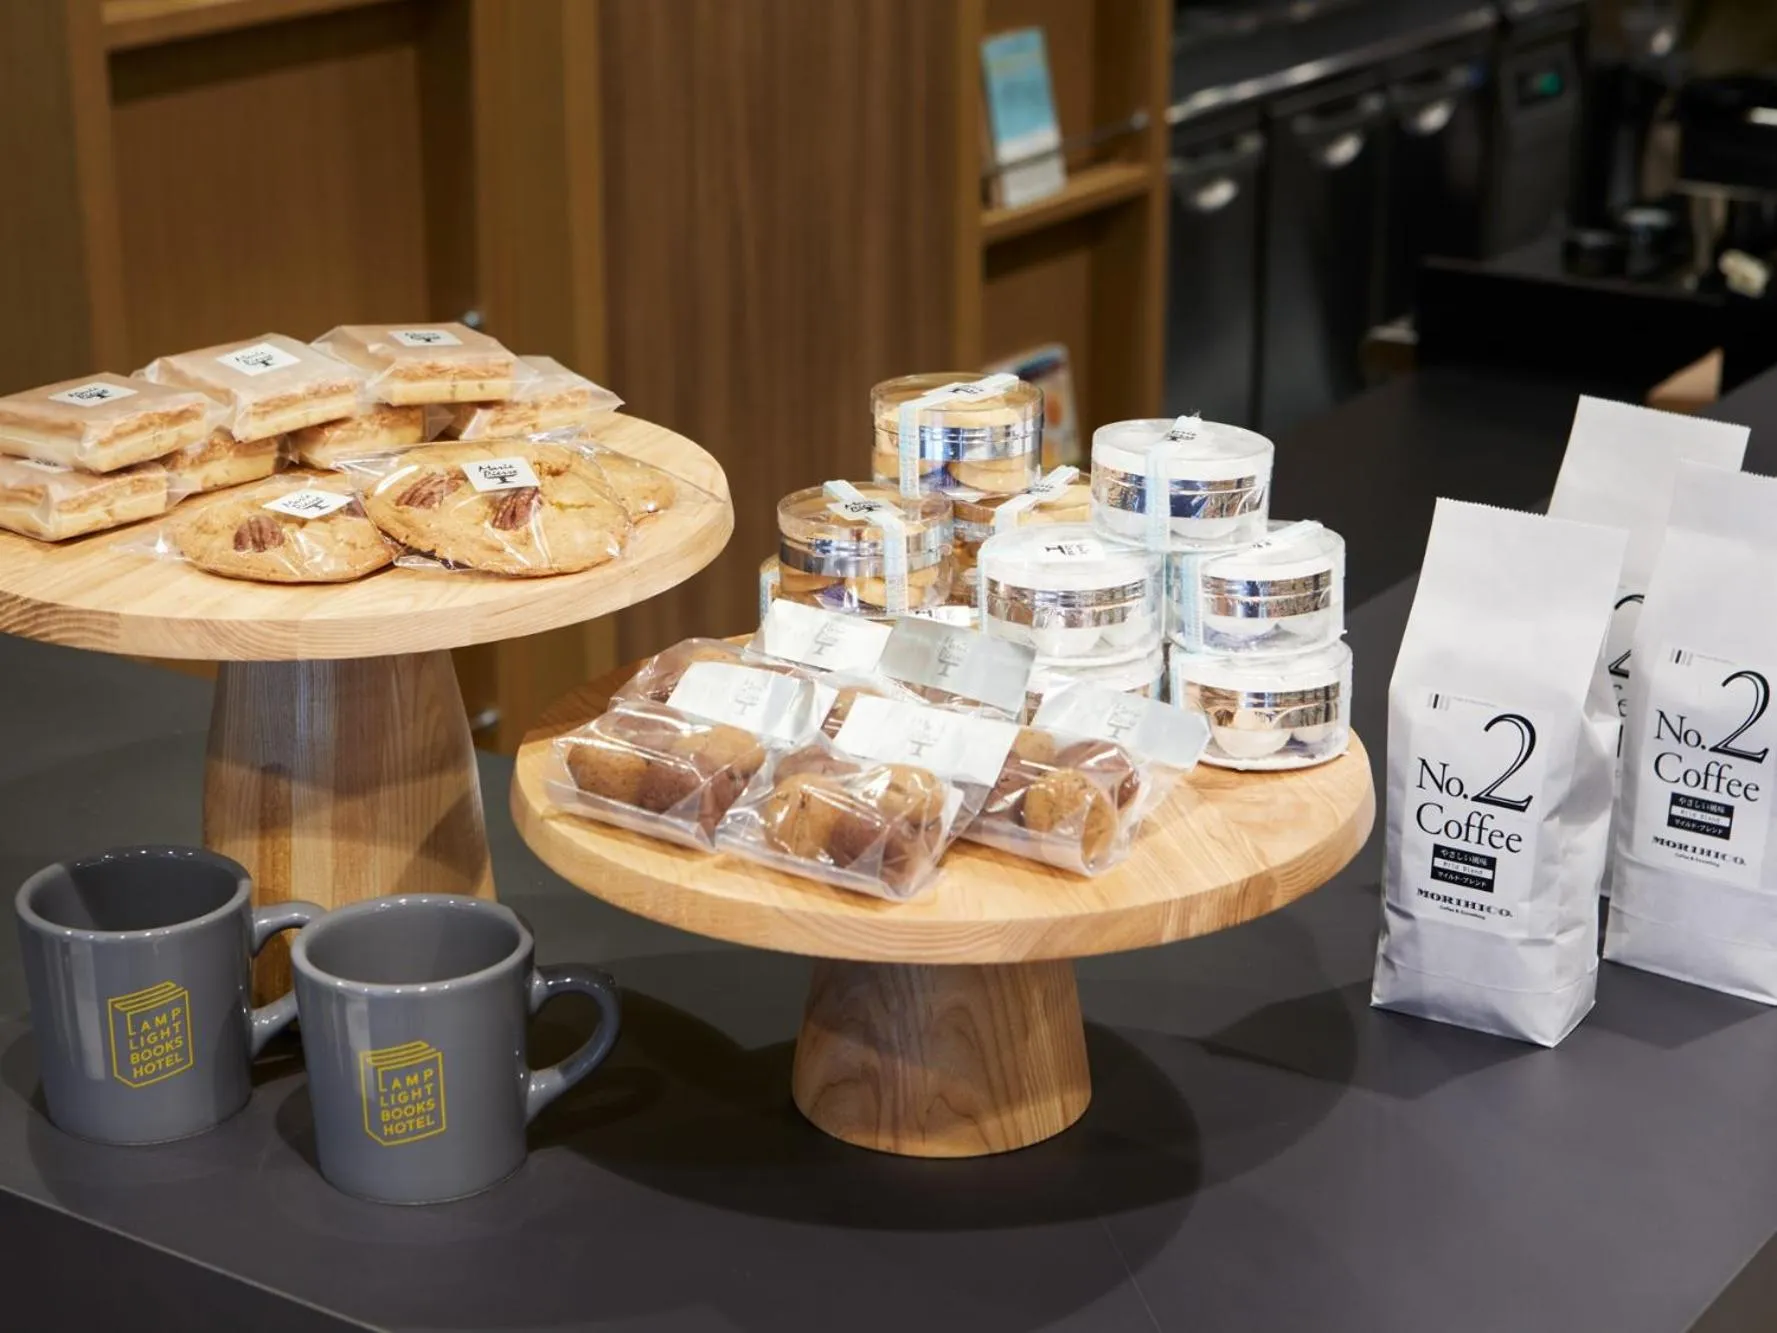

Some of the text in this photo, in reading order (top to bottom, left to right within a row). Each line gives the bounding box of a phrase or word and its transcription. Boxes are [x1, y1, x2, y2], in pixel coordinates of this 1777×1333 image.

[1654, 751, 1760, 802] Coffee
[1416, 802, 1523, 854] Coffee
[127, 1007, 181, 1036] LAMP
[129, 1021, 182, 1050] LIGHT
[130, 1036, 183, 1064] BOOKS
[133, 1052, 184, 1079] HOTEL
[378, 1068, 434, 1093] LAMP
[380, 1083, 434, 1107] LIGHT
[381, 1098, 435, 1122] BOOKS
[383, 1115, 435, 1135] HOTEL
